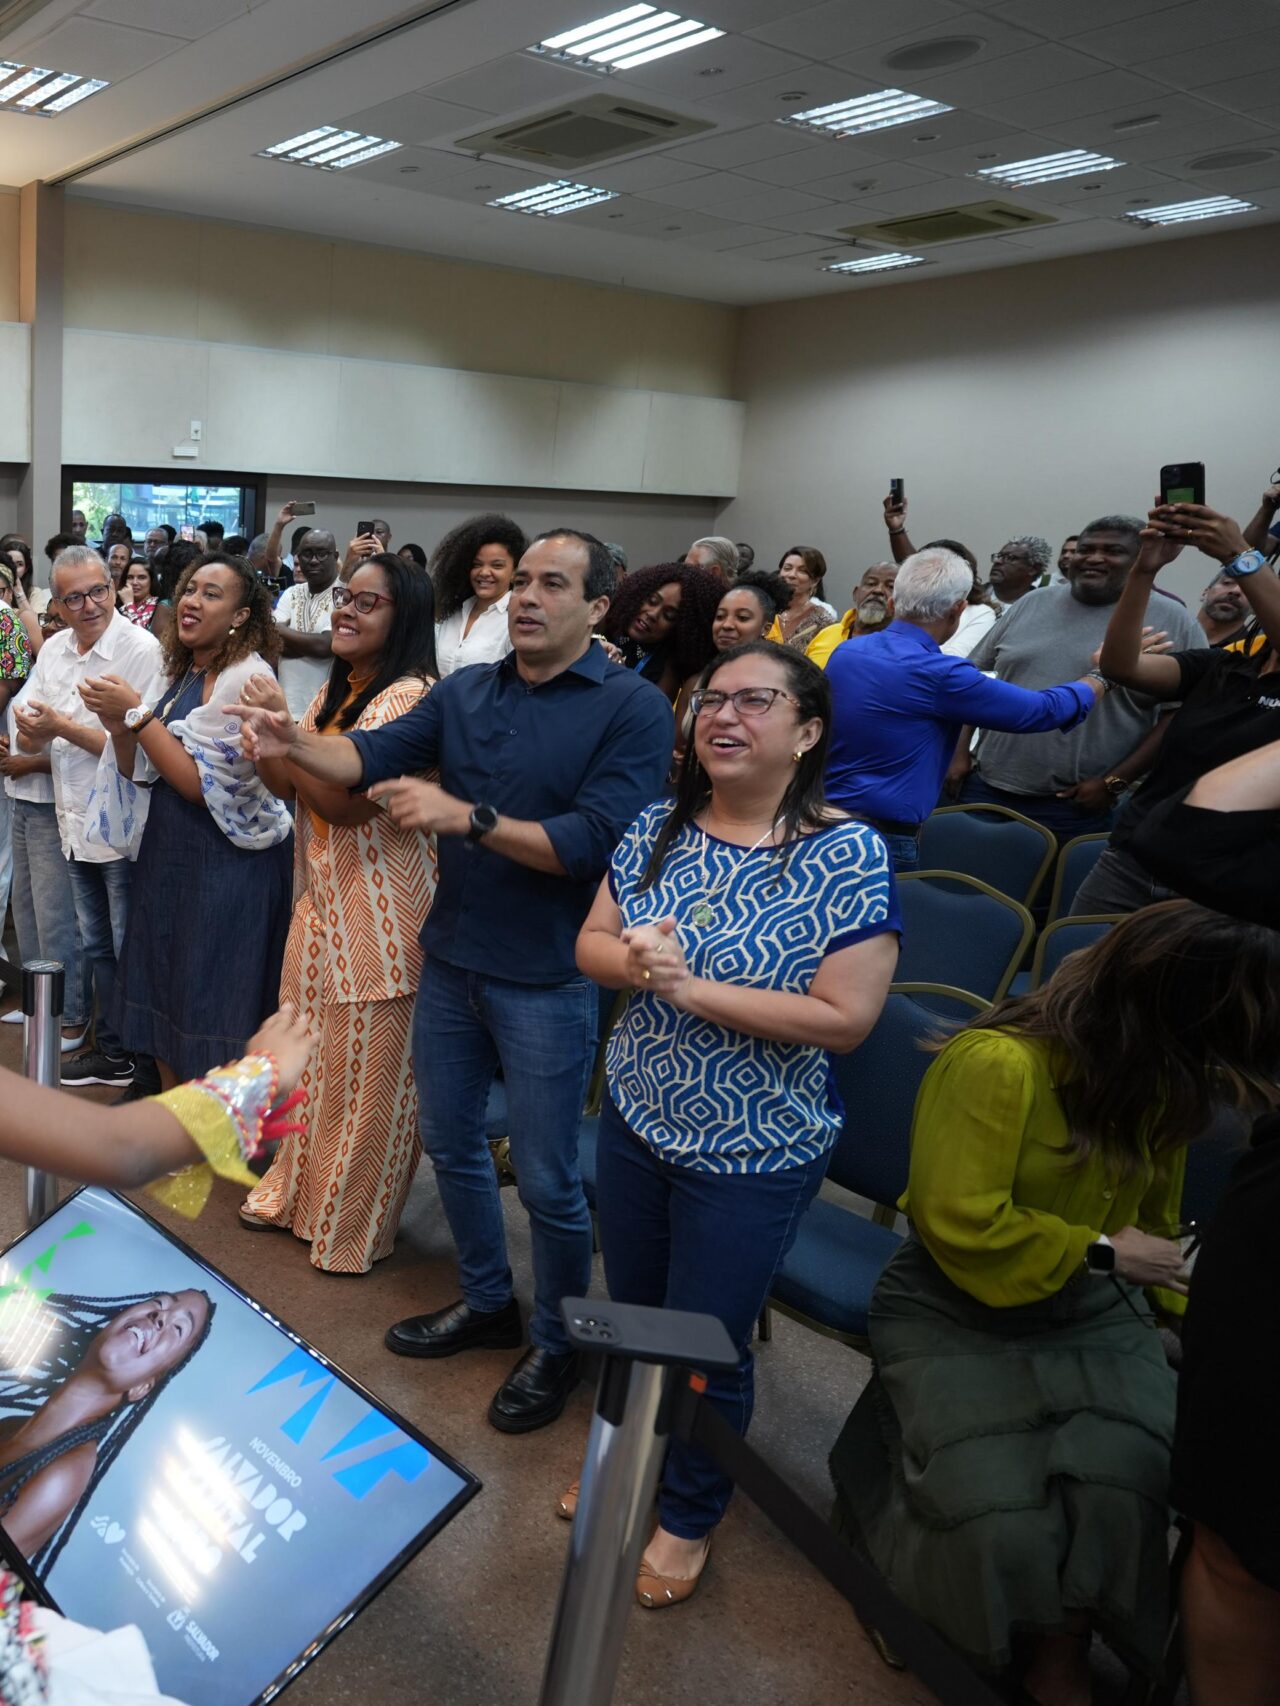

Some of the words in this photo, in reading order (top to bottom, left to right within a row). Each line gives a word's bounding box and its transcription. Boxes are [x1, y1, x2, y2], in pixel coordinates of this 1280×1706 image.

[249, 1436, 302, 1488] NOVEMBRO
[201, 1436, 307, 1542] SALVADOR
[185, 1620, 220, 1662] SALVADOR
